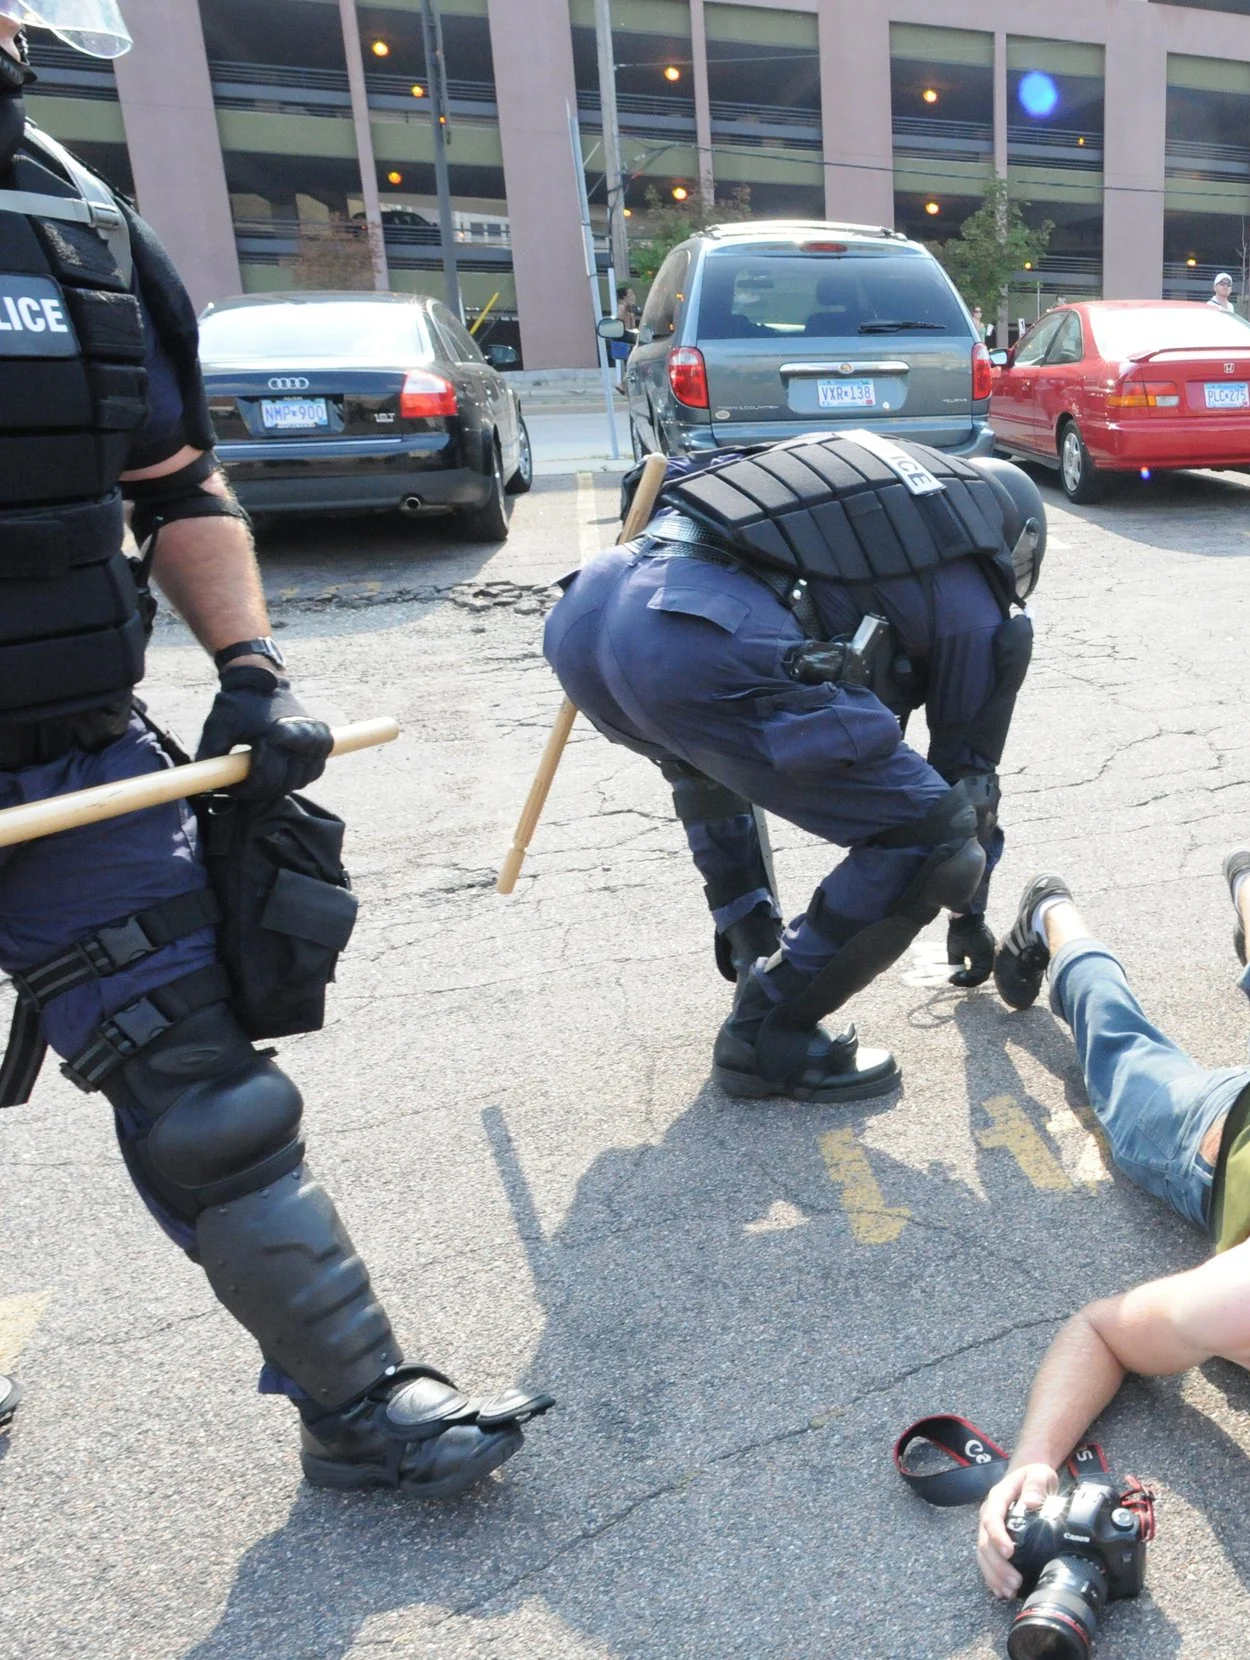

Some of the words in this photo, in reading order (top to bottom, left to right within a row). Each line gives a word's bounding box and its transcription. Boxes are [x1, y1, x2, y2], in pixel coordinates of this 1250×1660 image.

[822, 386, 843, 401] VXR
[850, 386, 871, 400] 138
[1208, 390, 1226, 402] PLC
[1229, 389, 1247, 402] 275
[265, 406, 291, 421] NMP
[300, 405, 325, 420] 900
[1063, 1531, 1090, 1543] Canon
